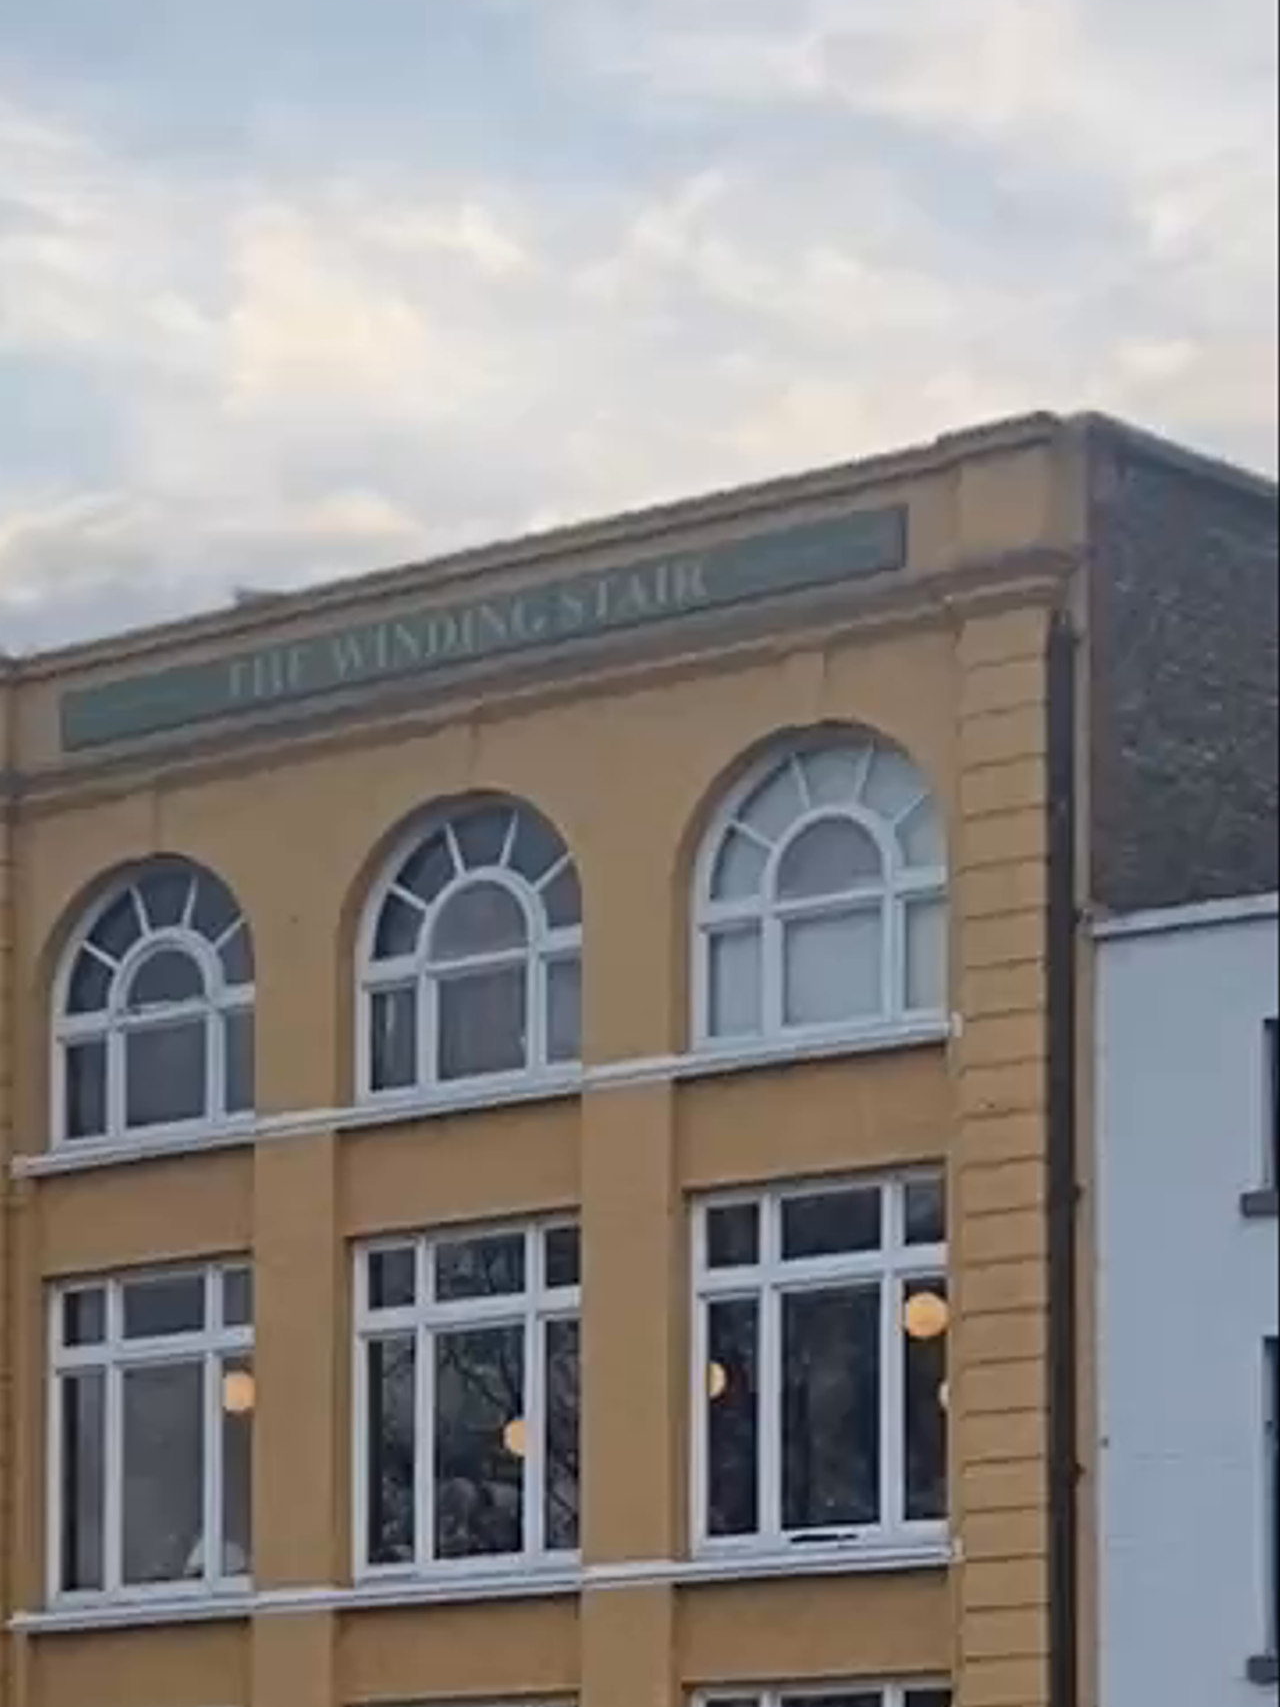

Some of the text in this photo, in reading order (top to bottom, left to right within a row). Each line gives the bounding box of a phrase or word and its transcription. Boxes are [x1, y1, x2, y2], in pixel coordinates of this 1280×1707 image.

[229, 561, 709, 696] THE WINDING STAIR
